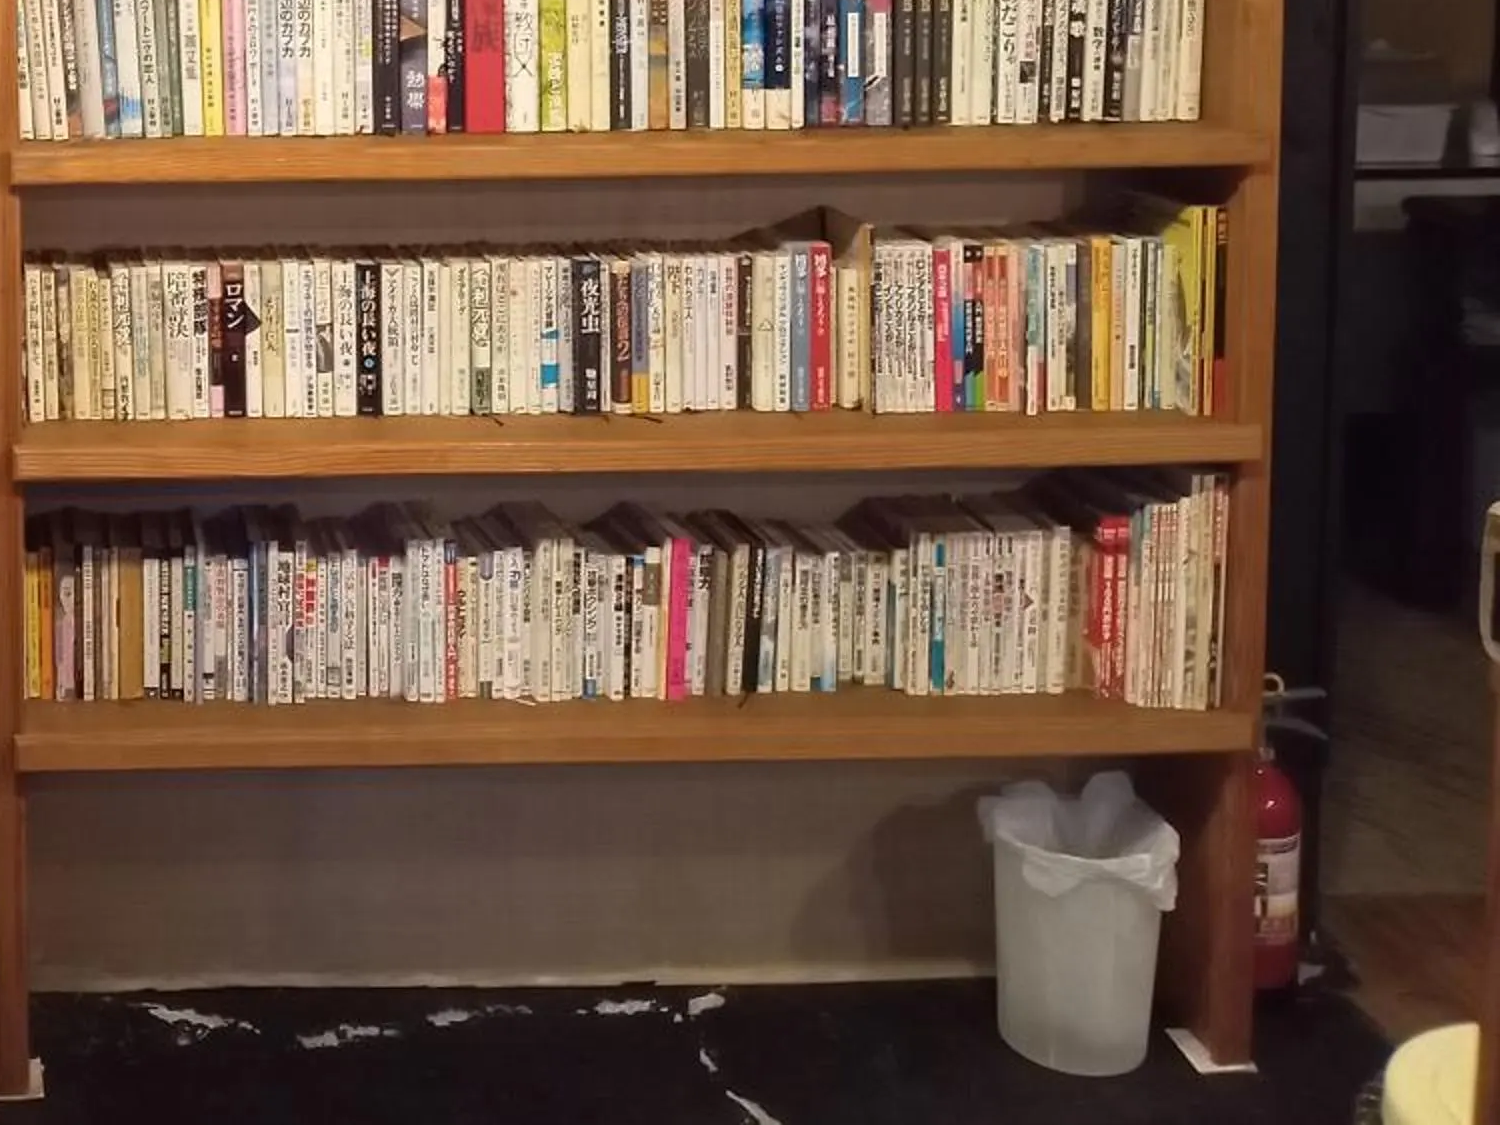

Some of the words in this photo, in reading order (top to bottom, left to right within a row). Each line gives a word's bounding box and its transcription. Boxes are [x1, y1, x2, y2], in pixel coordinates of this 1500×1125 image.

[224, 283, 246, 329] ロマン
[339, 270, 353, 356] 上海の長い夜
[360, 270, 376, 355] 上海の長い夜
[580, 278, 600, 334] 夜光虫
